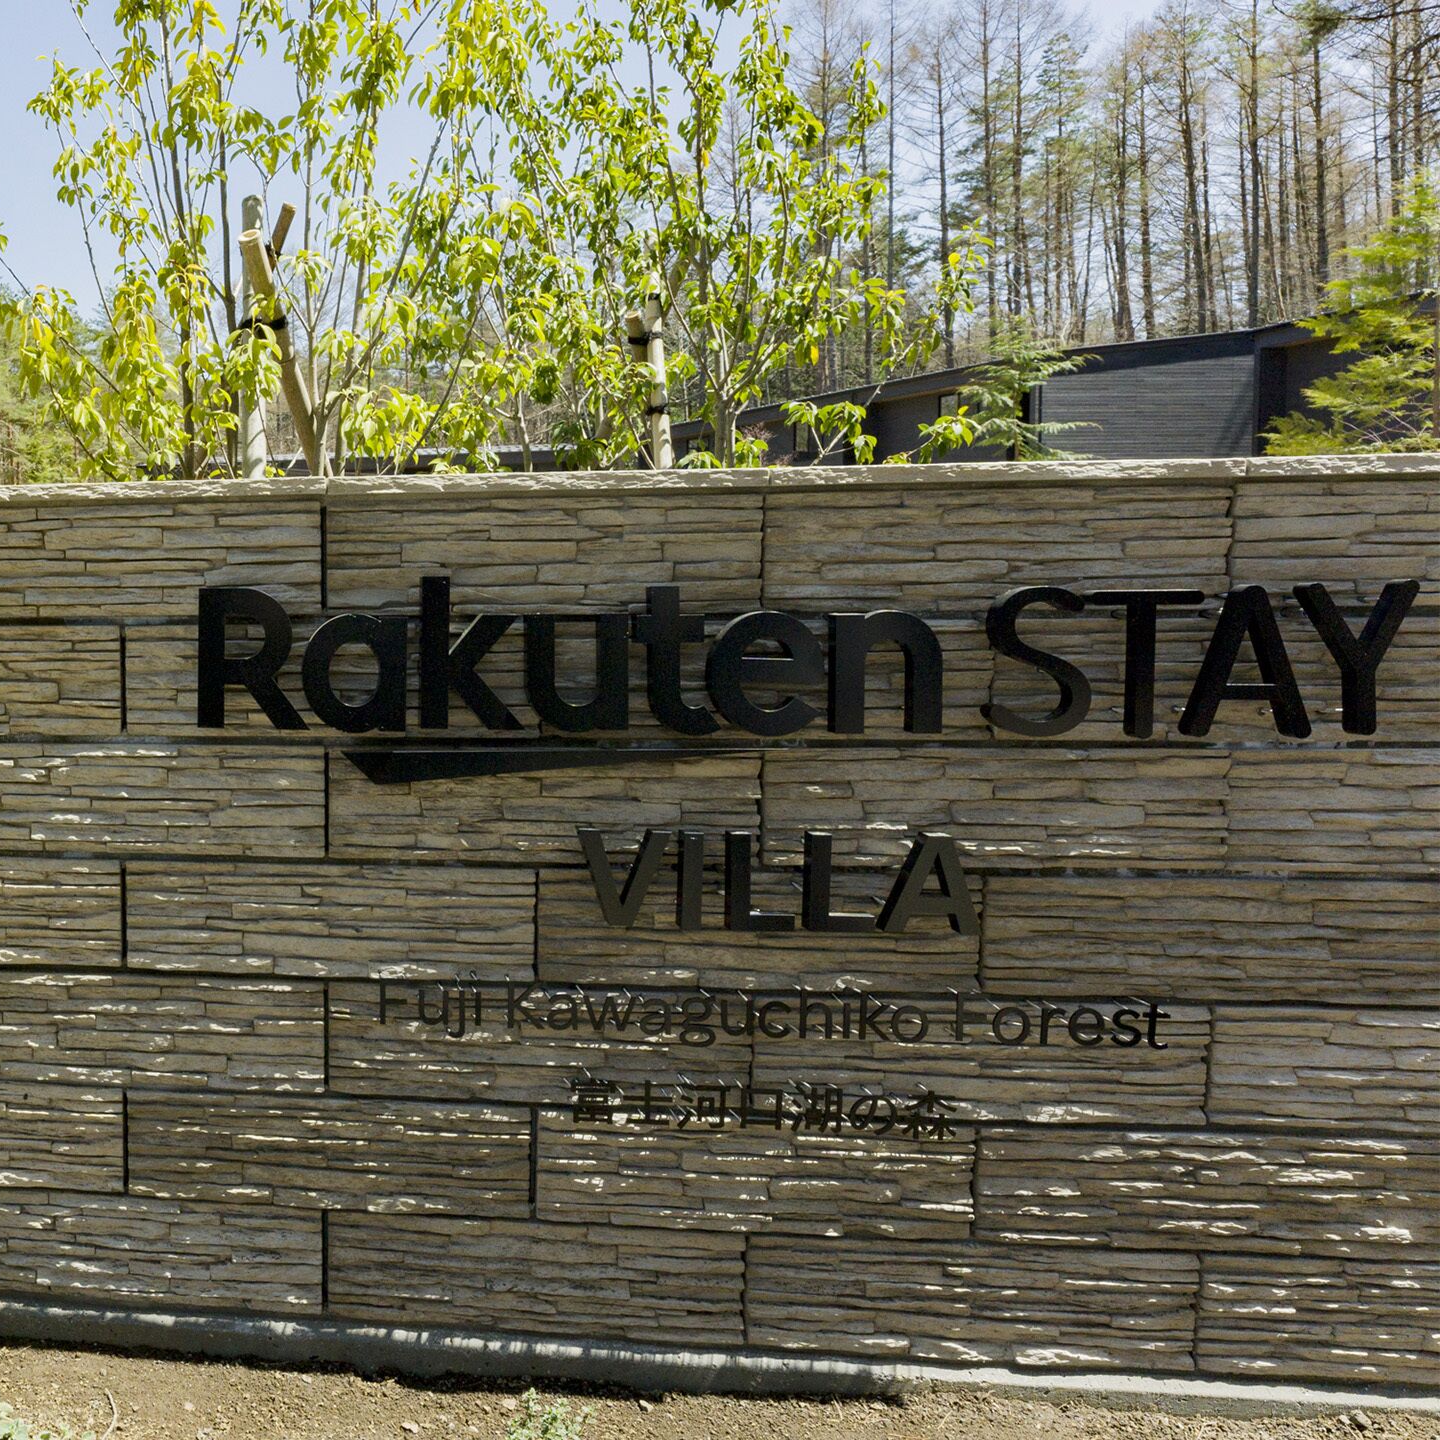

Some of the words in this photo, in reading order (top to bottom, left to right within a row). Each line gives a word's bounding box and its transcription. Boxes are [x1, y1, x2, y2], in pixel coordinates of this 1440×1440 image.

[197, 576, 942, 735] Rakuten
[981, 579, 1419, 740] STAY
[576, 827, 980, 935] VILLA
[377, 977, 482, 1038] Fuji
[505, 977, 929, 1047] Kawaguchiko
[954, 987, 1171, 1050] Forest
[570, 1079, 958, 1141] 富士河口湖の森
